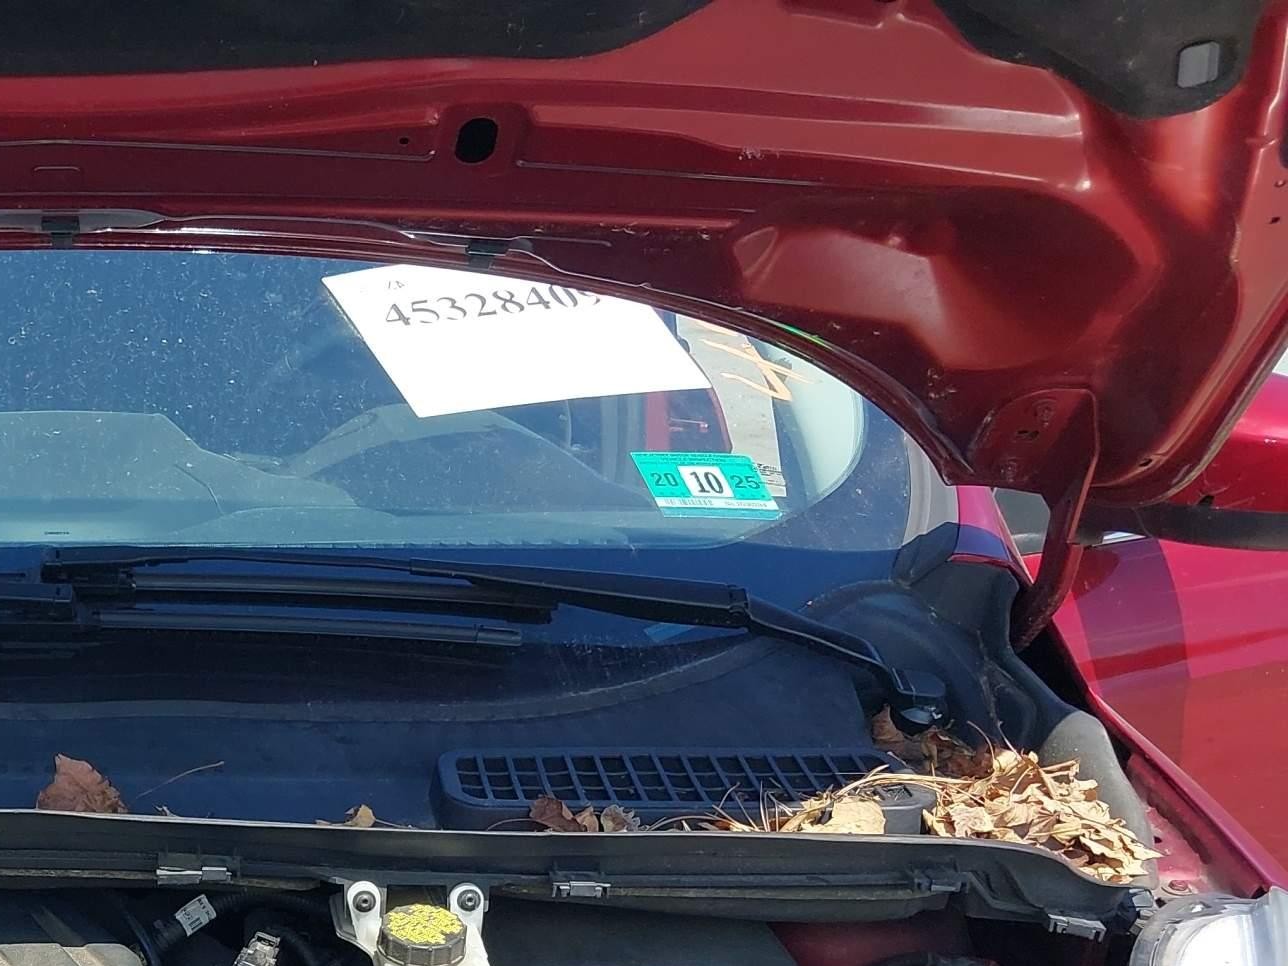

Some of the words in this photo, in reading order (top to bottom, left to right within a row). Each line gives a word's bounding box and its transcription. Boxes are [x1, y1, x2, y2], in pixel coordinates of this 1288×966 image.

[651, 472, 679, 487] 20
[690, 471, 723, 494] 10
[730, 475, 761, 490] 25
